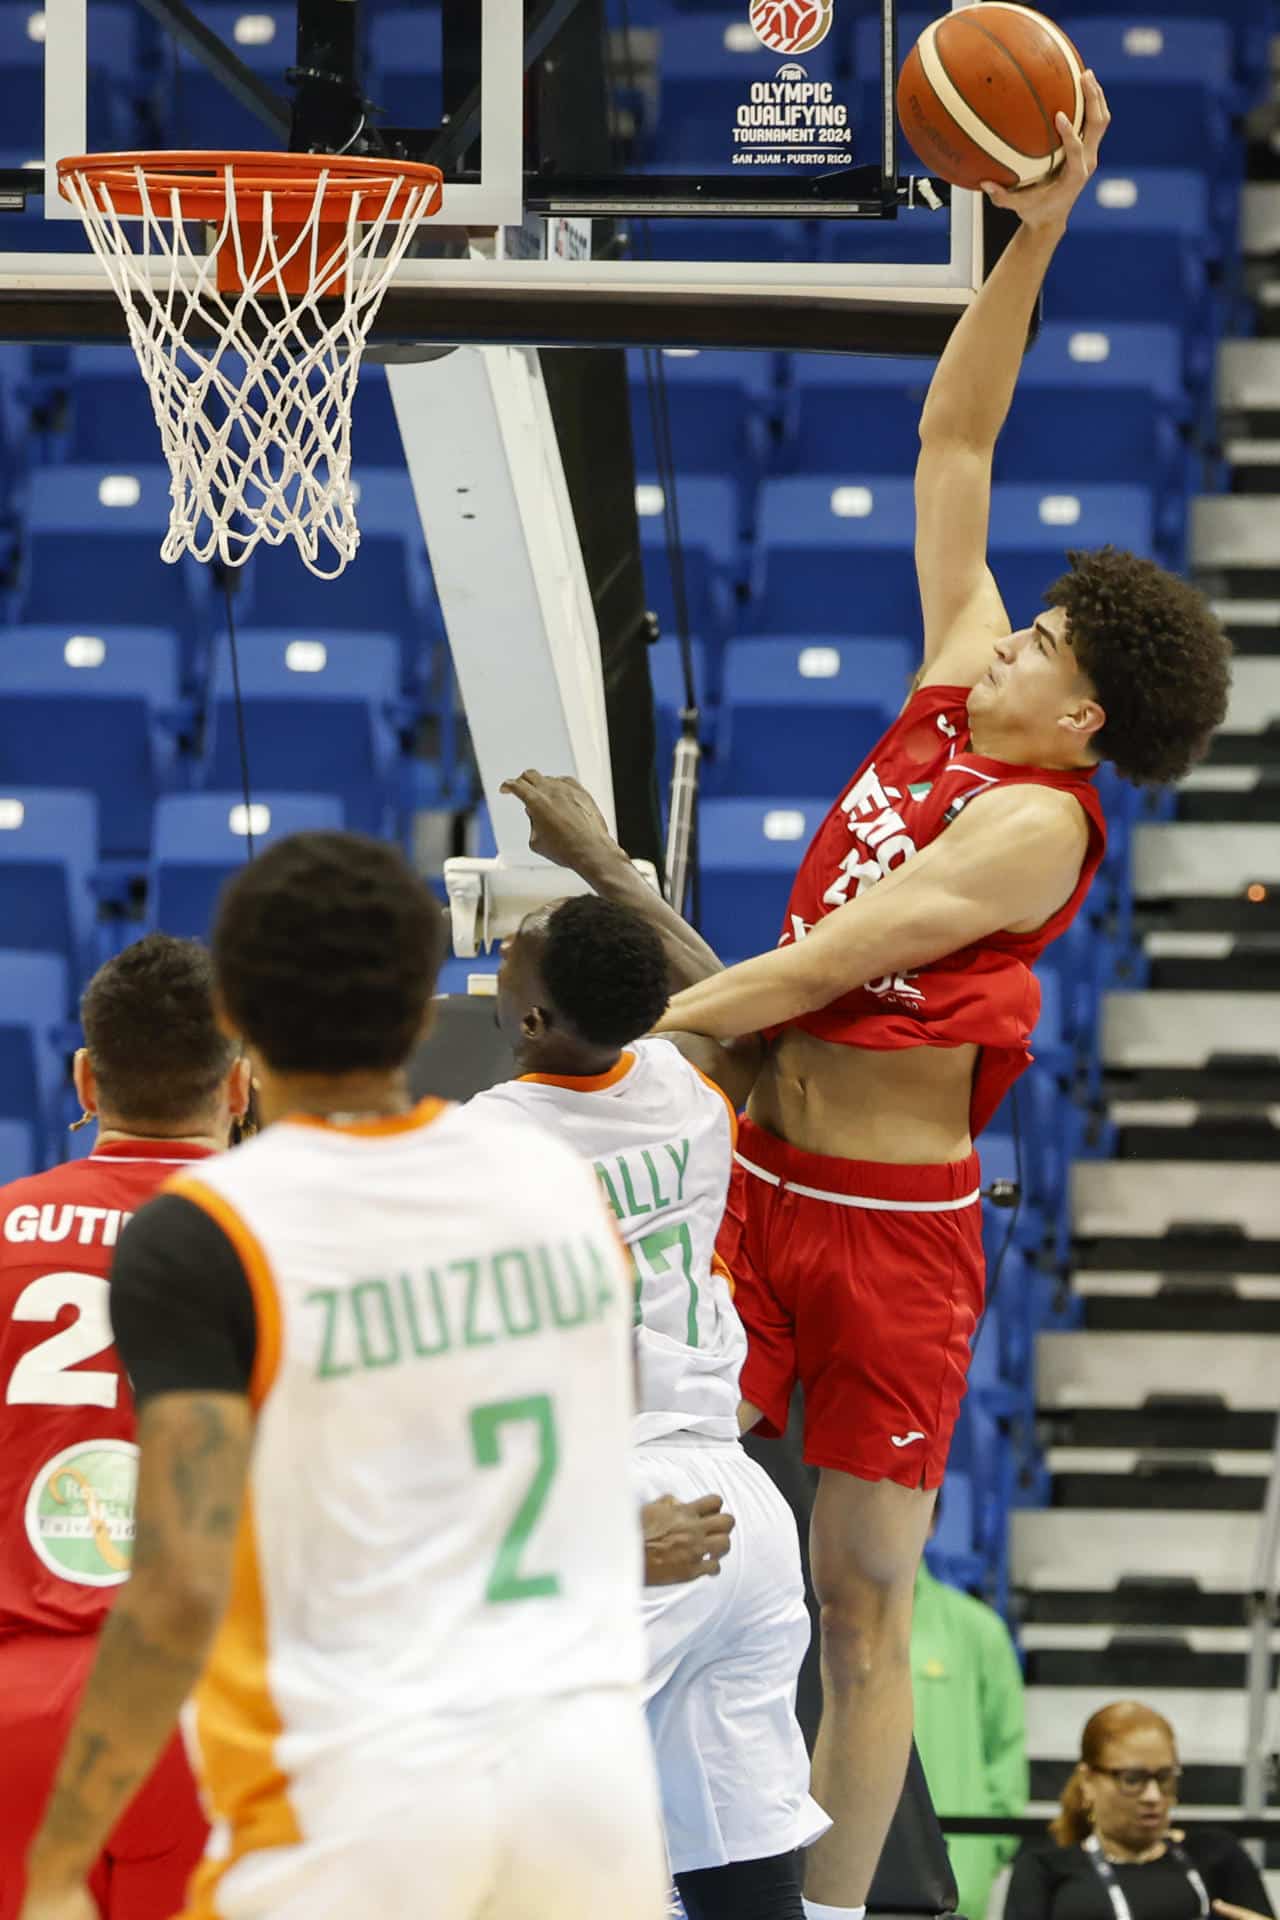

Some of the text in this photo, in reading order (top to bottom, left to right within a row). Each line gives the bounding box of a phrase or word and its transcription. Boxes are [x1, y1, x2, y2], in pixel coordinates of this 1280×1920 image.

[750, 82, 833, 104] OLYMPIC
[737, 104, 847, 127] QUALIFYING
[732, 128, 852, 142] TOURNAMENT 2024
[732, 153, 852, 164] SAN JUAN PUERTO RICO
[468, 1392, 561, 1604] 2
